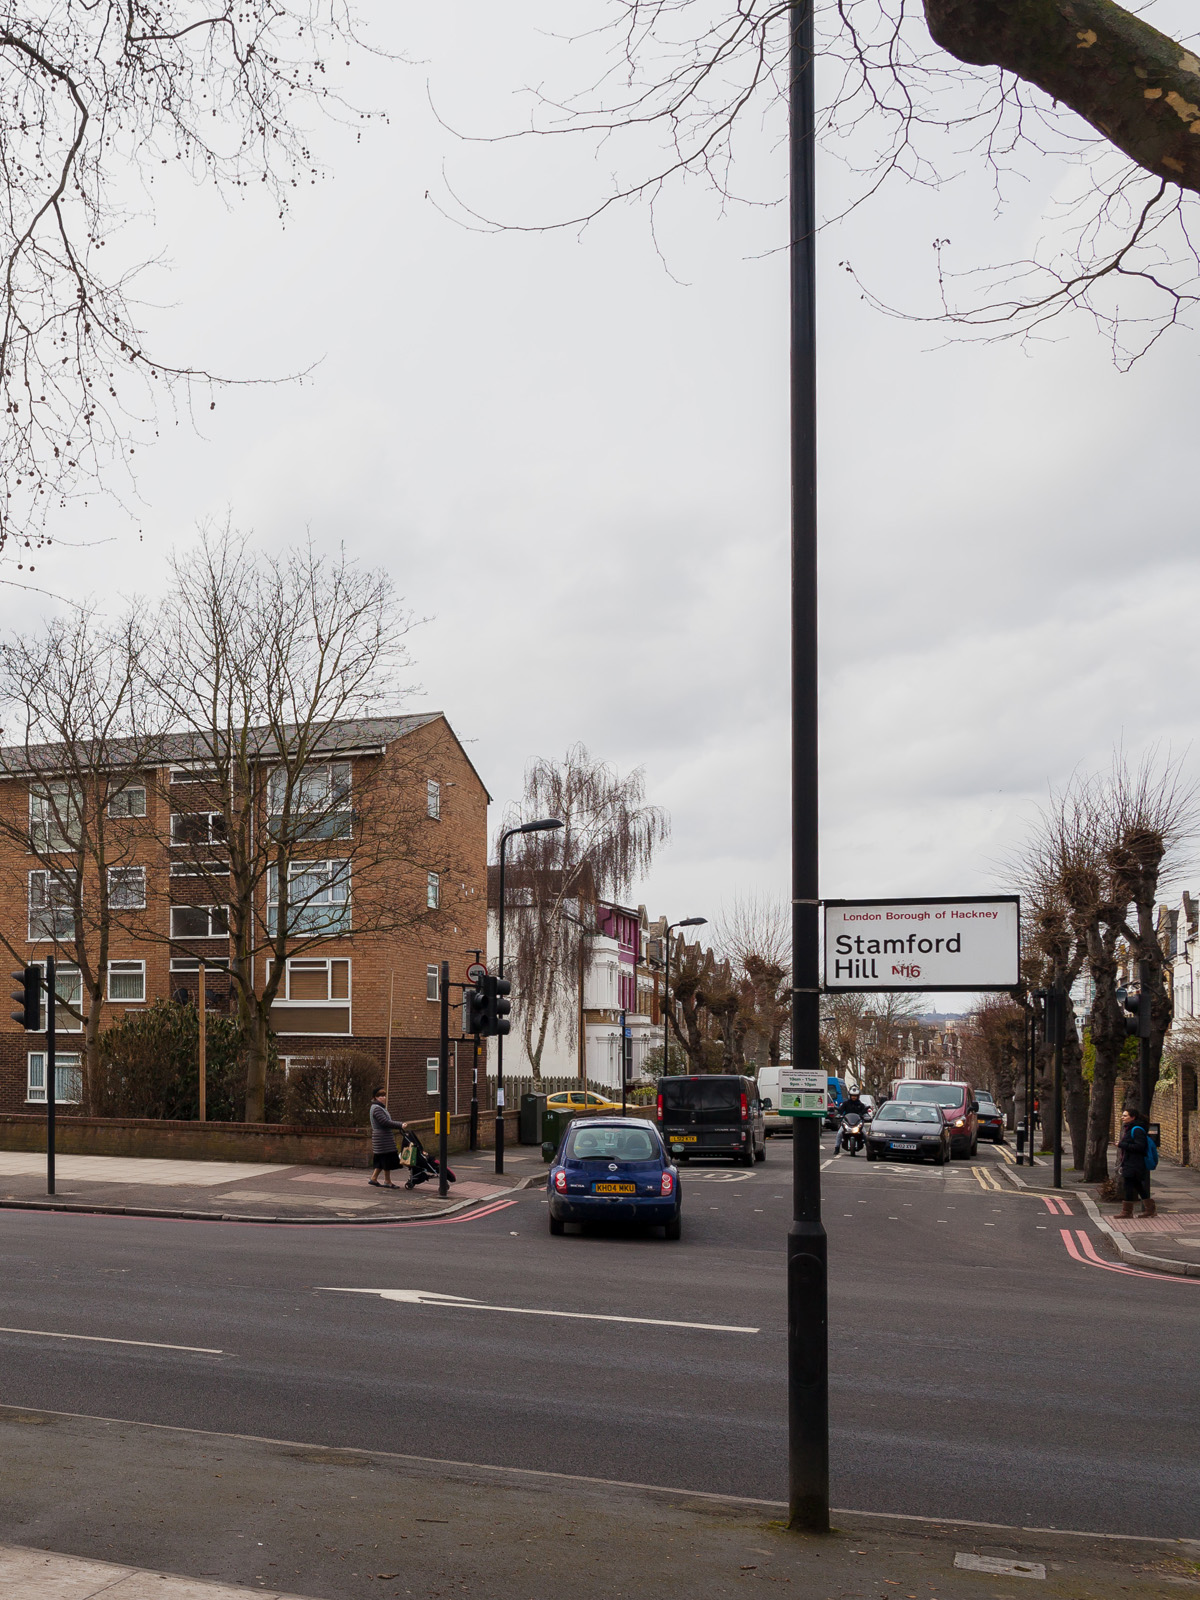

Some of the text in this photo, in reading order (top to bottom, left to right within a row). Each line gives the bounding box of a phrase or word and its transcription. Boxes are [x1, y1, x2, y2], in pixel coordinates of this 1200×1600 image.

[843, 910, 998, 921] London Borough of Hackney
[835, 932, 961, 955] Stamford
[835, 958, 921, 979] Hill N16
[596, 1184, 634, 1192] KH04 MKU
